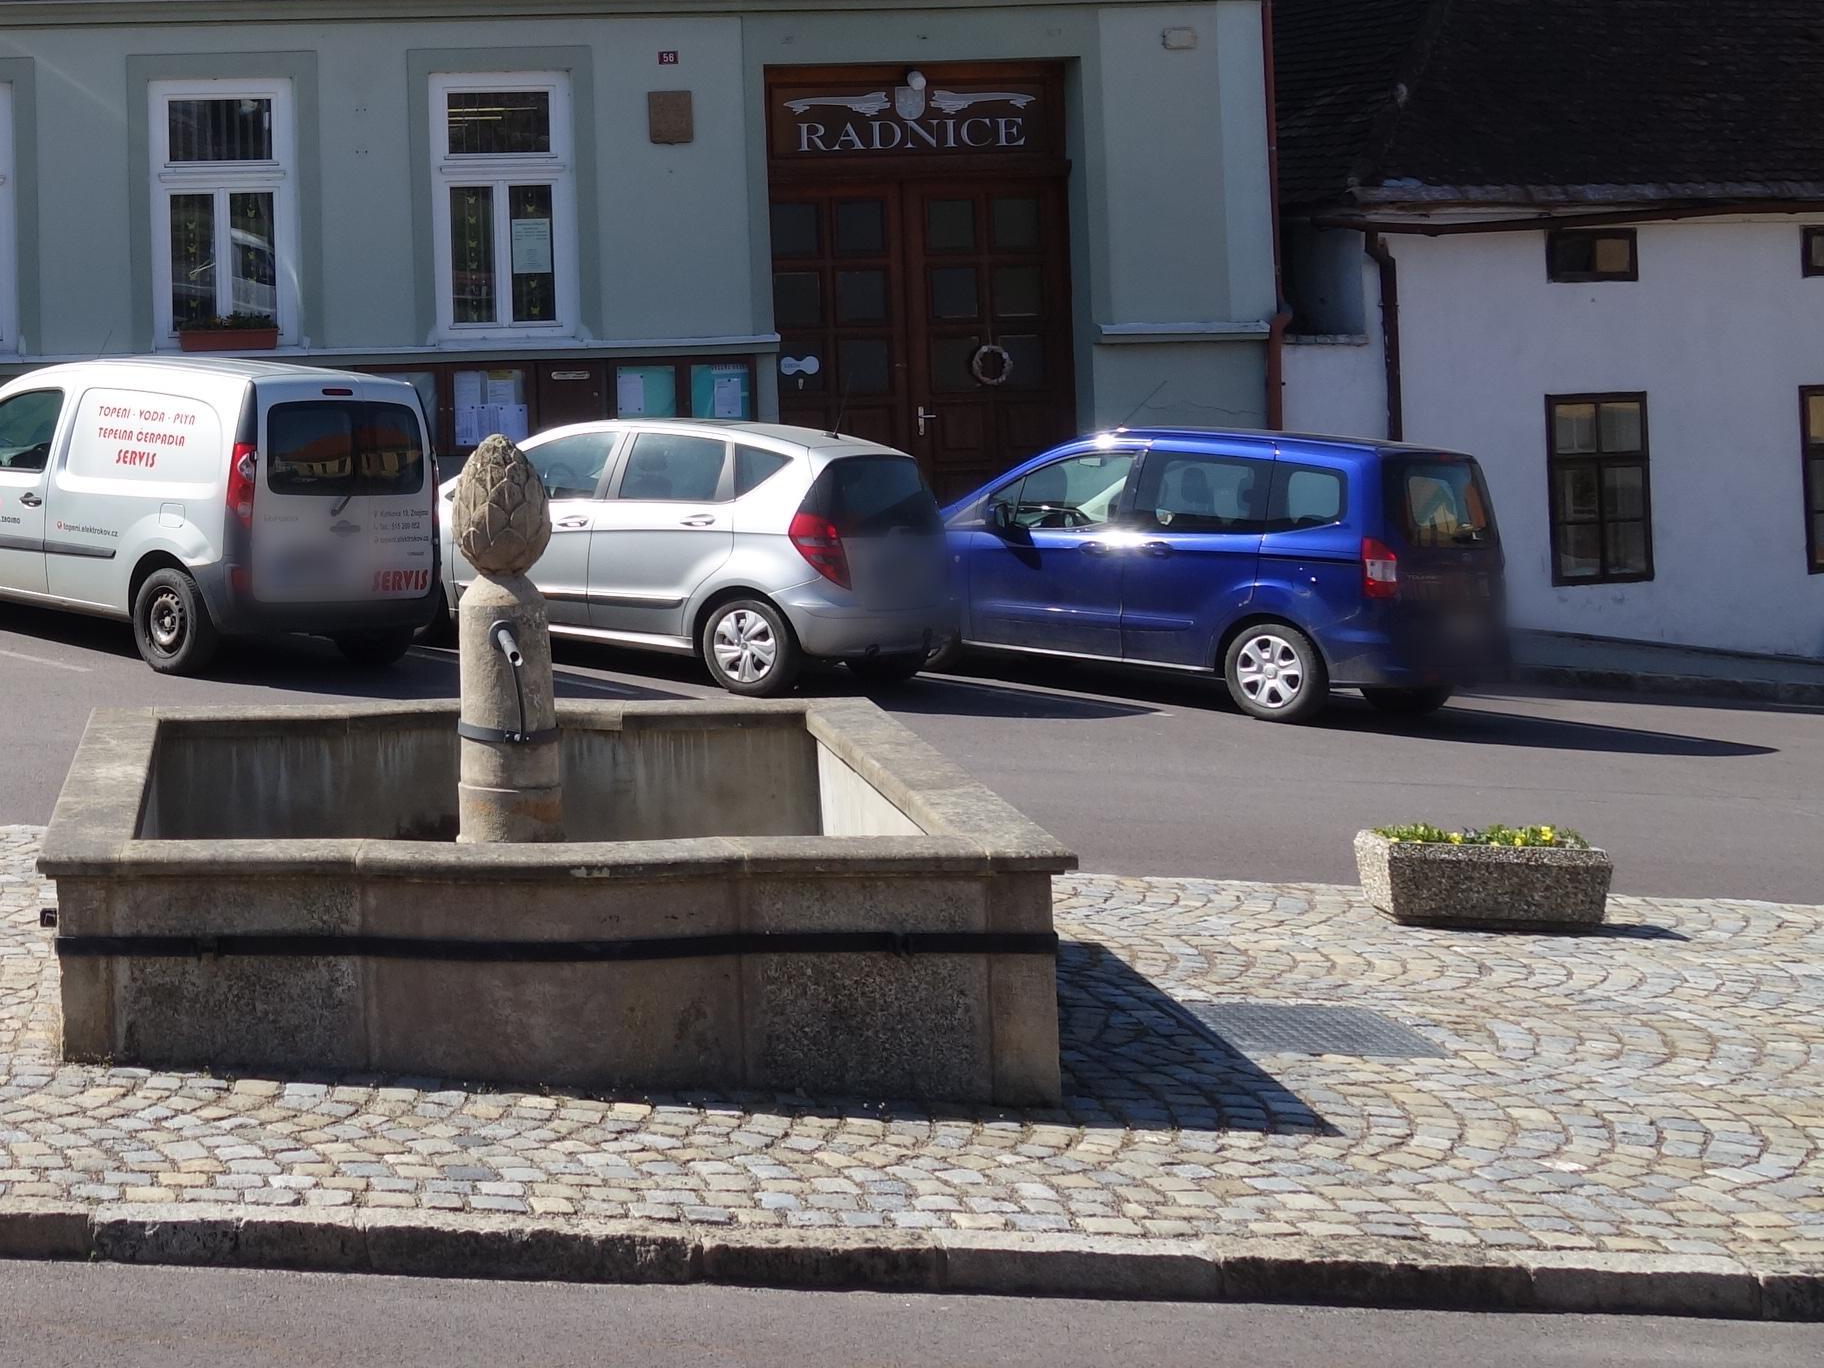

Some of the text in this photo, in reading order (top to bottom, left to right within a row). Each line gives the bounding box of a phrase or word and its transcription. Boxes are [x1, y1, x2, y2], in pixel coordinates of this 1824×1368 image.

[796, 116, 1027, 152] RADNICE
[138, 409, 165, 423] VODA
[173, 412, 196, 426] PLYN
[116, 448, 157, 468] SERVIS
[372, 570, 429, 592] SERVIS
